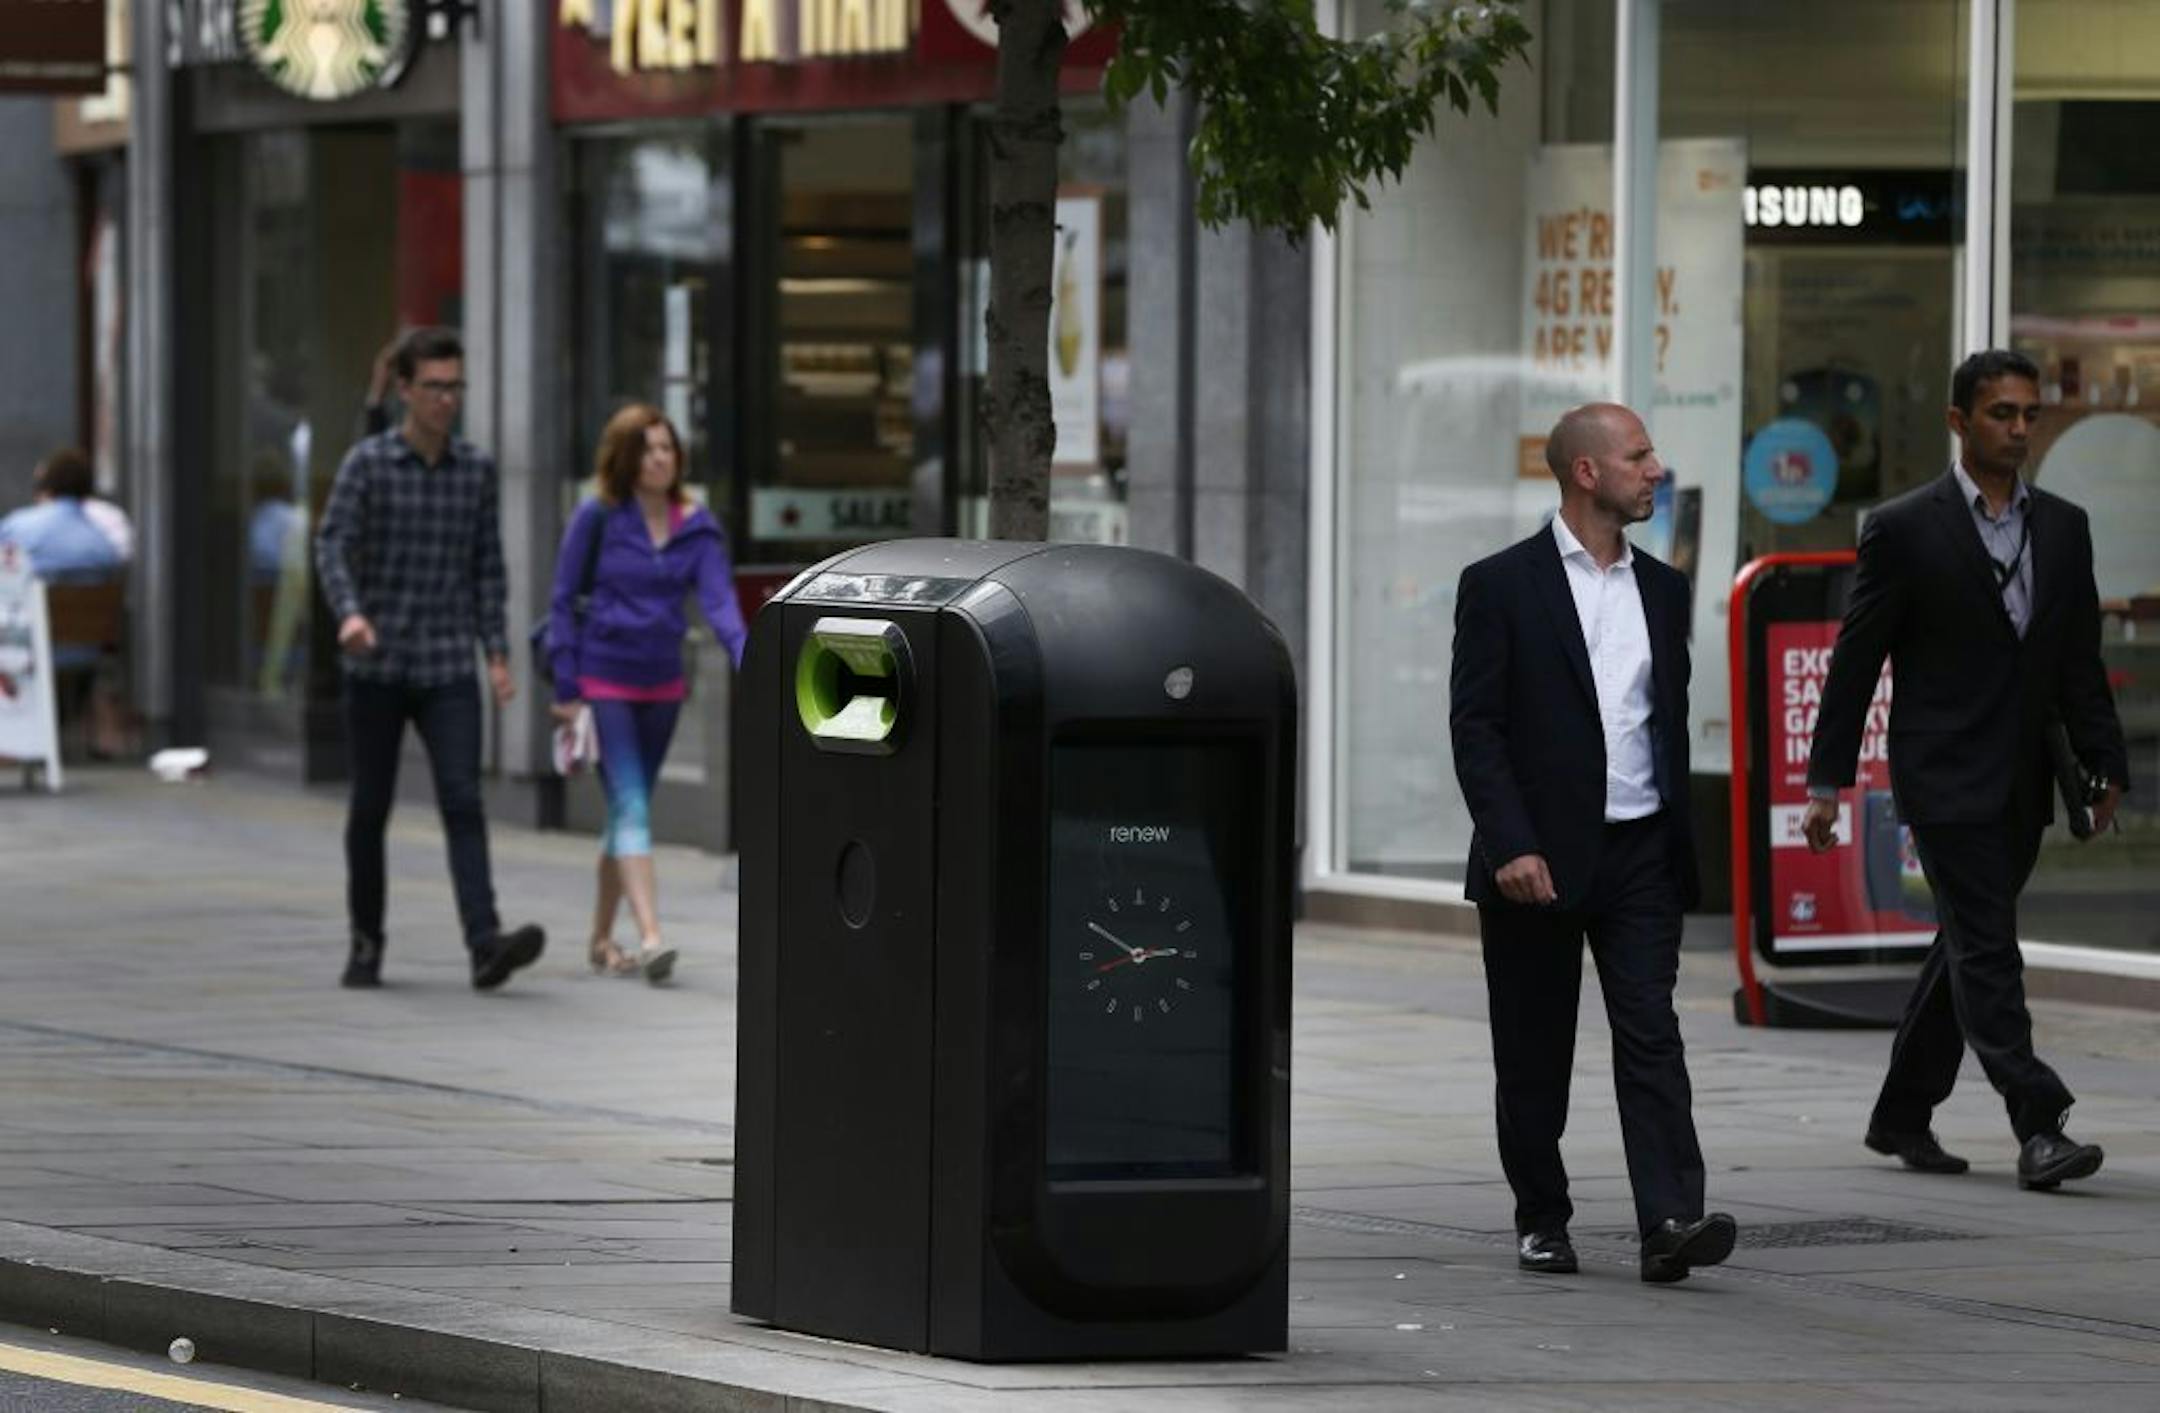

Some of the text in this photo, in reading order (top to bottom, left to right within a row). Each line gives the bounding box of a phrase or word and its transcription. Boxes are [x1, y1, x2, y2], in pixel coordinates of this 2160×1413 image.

[1536, 205, 1615, 261] WE'R
[1535, 266, 1679, 317] 4G REY.
[1110, 825, 1170, 843] renew
